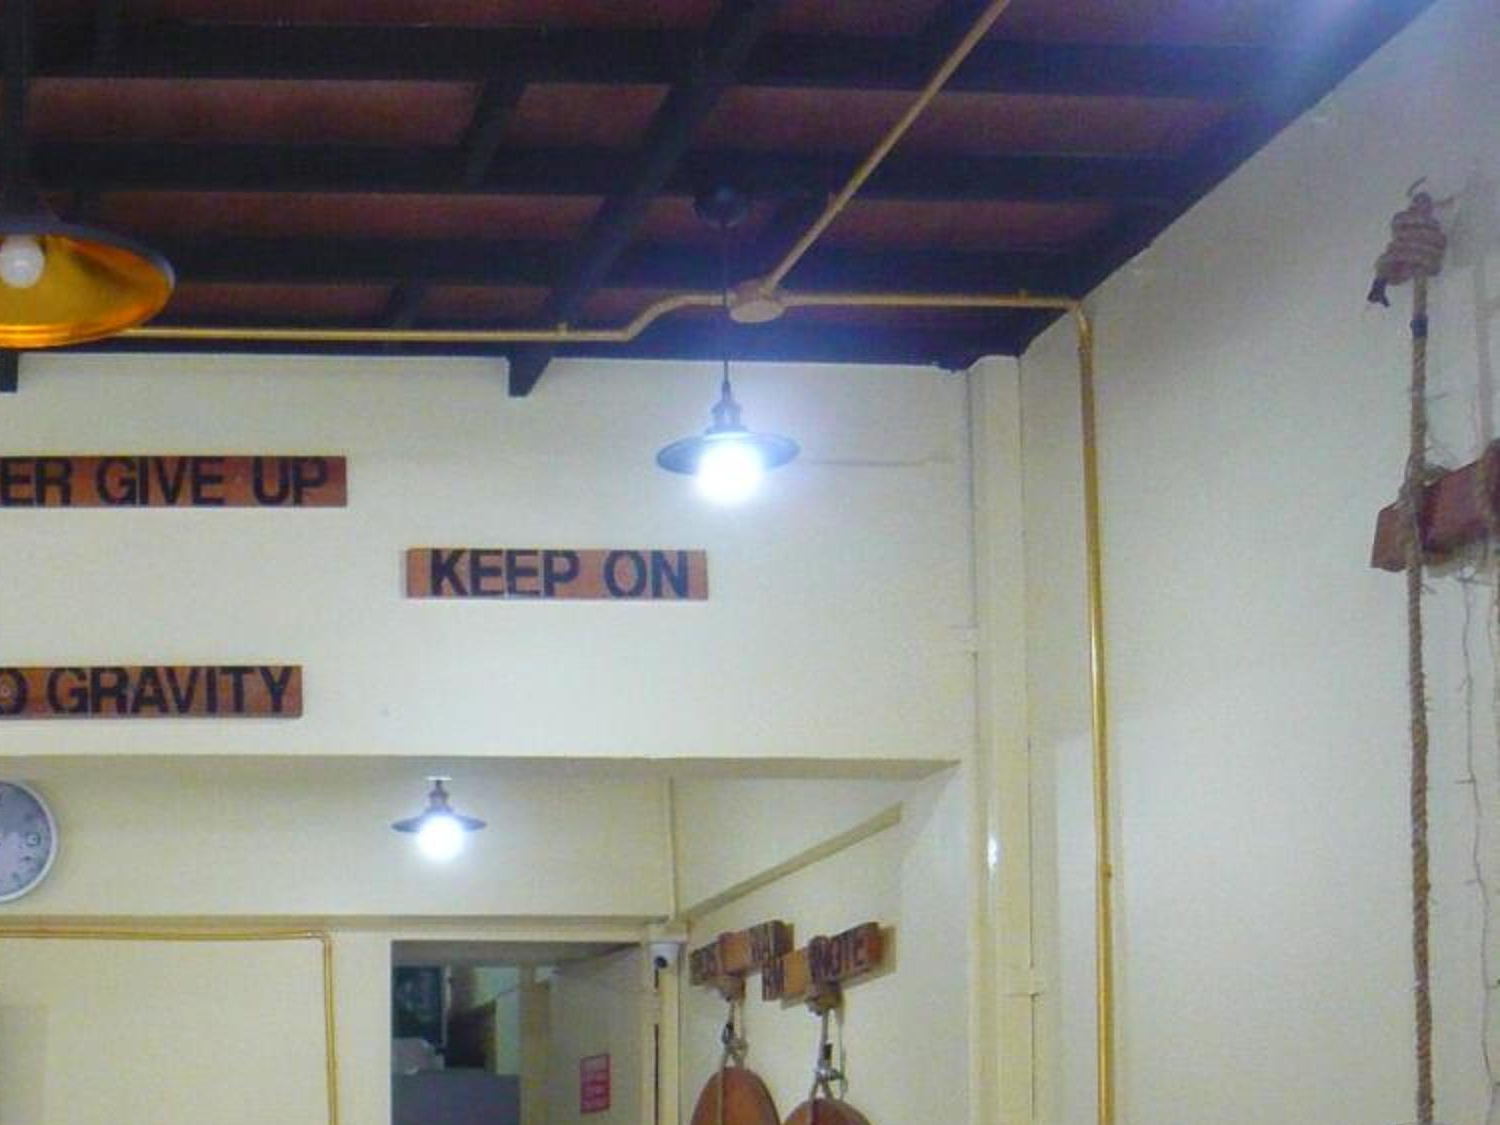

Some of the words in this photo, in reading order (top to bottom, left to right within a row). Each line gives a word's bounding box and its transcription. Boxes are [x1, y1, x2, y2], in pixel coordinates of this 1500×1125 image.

[94, 457, 226, 507] GIVE
[251, 456, 329, 506] UP
[429, 549, 580, 598] KEEP
[603, 549, 689, 598] ON
[48, 666, 296, 716] GRAVITY
